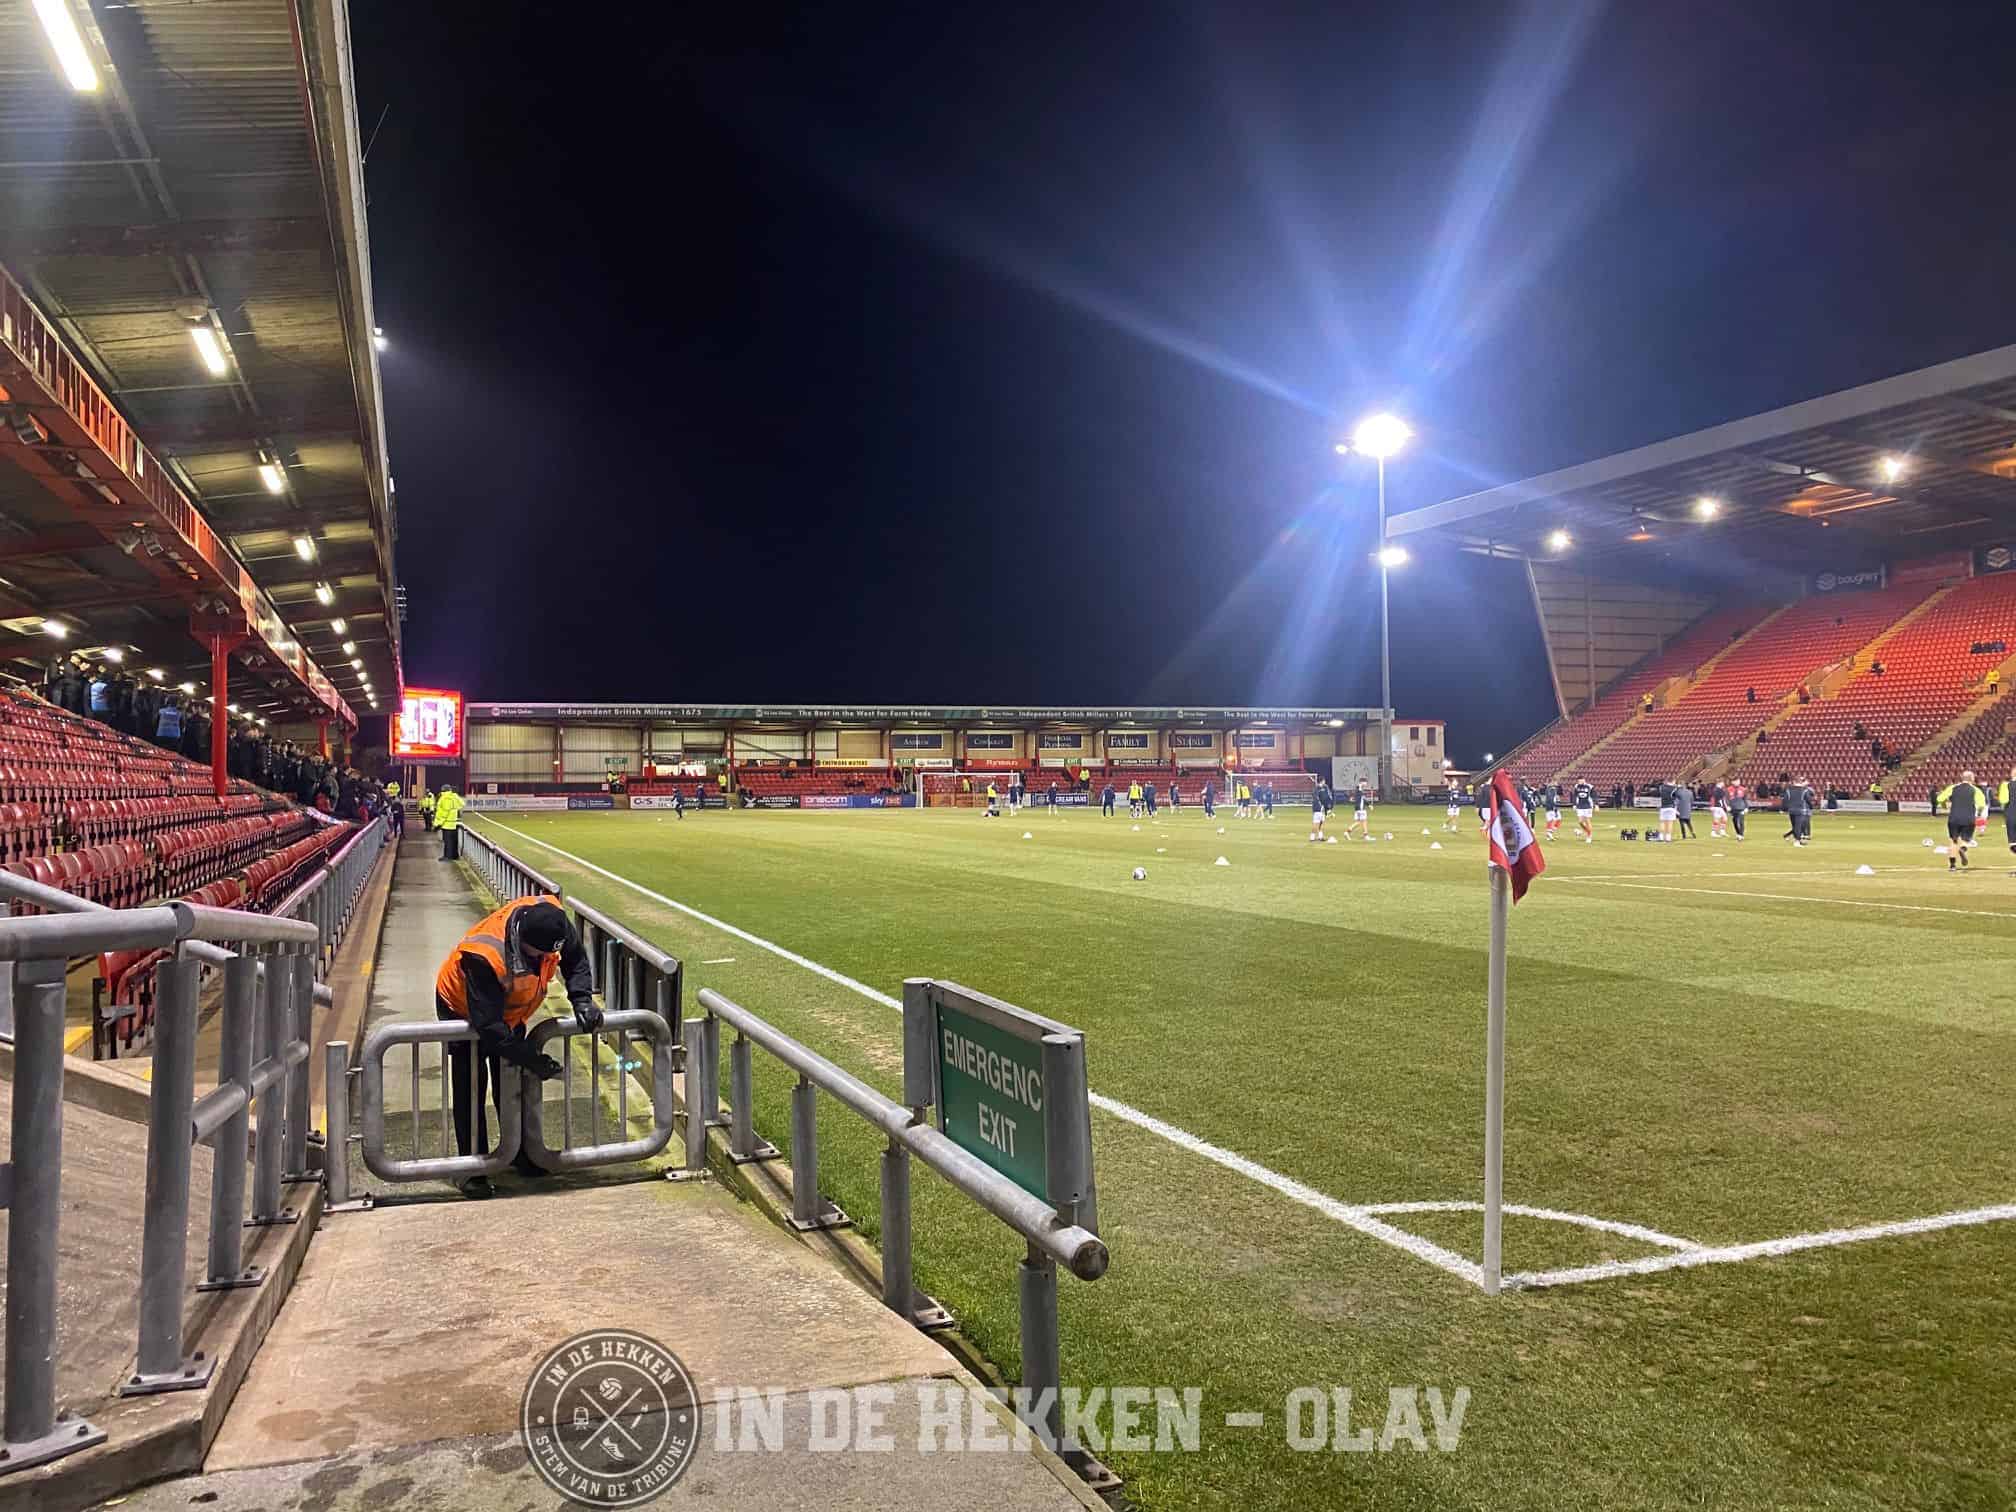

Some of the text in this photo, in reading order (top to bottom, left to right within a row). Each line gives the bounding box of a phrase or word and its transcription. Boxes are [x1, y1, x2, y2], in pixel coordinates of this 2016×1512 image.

[558, 707, 611, 718] Independent
[614, 708, 641, 716] British
[644, 708, 672, 716] Millers
[870, 796, 884, 805] sky
[943, 1028, 1044, 1112] EMERGENC
[978, 1102, 1017, 1158] EXIT
